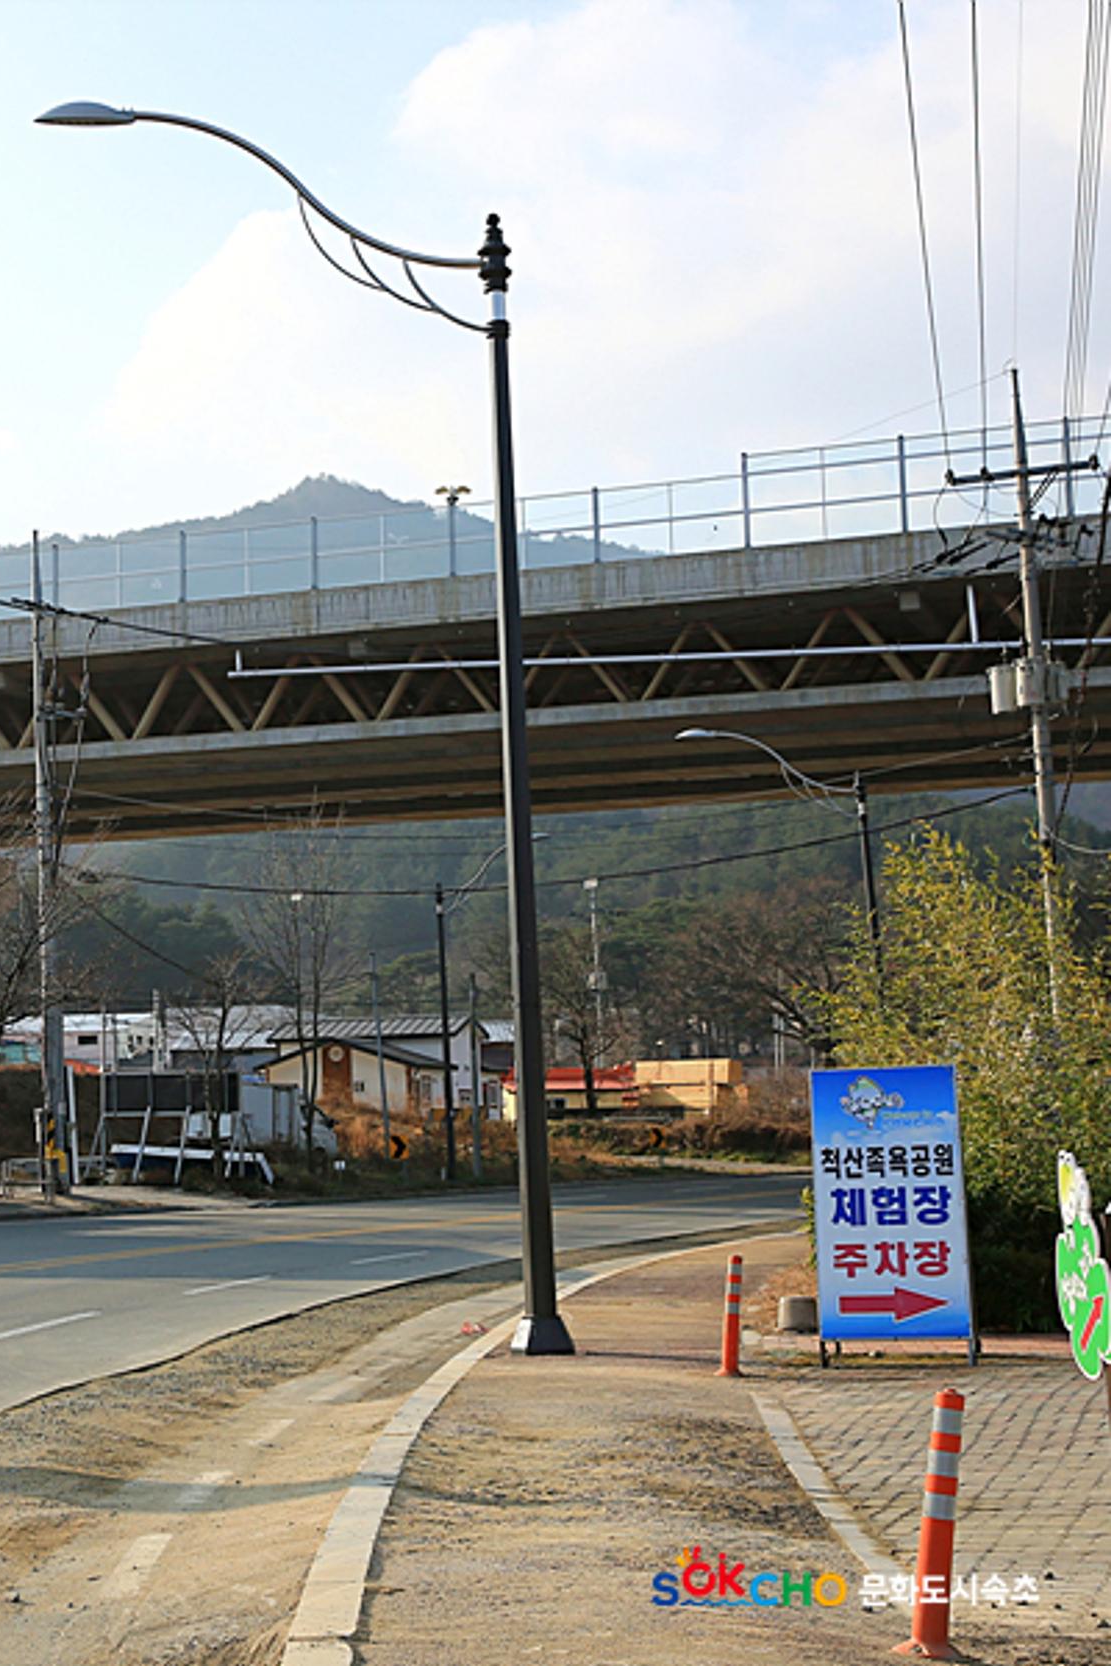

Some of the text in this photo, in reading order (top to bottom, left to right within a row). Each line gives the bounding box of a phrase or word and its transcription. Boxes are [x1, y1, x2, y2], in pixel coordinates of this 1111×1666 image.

[821, 1144, 954, 1179] 척산족욕공원
[830, 1186, 951, 1226] 체험장
[833, 1240, 951, 1278] 주차장
